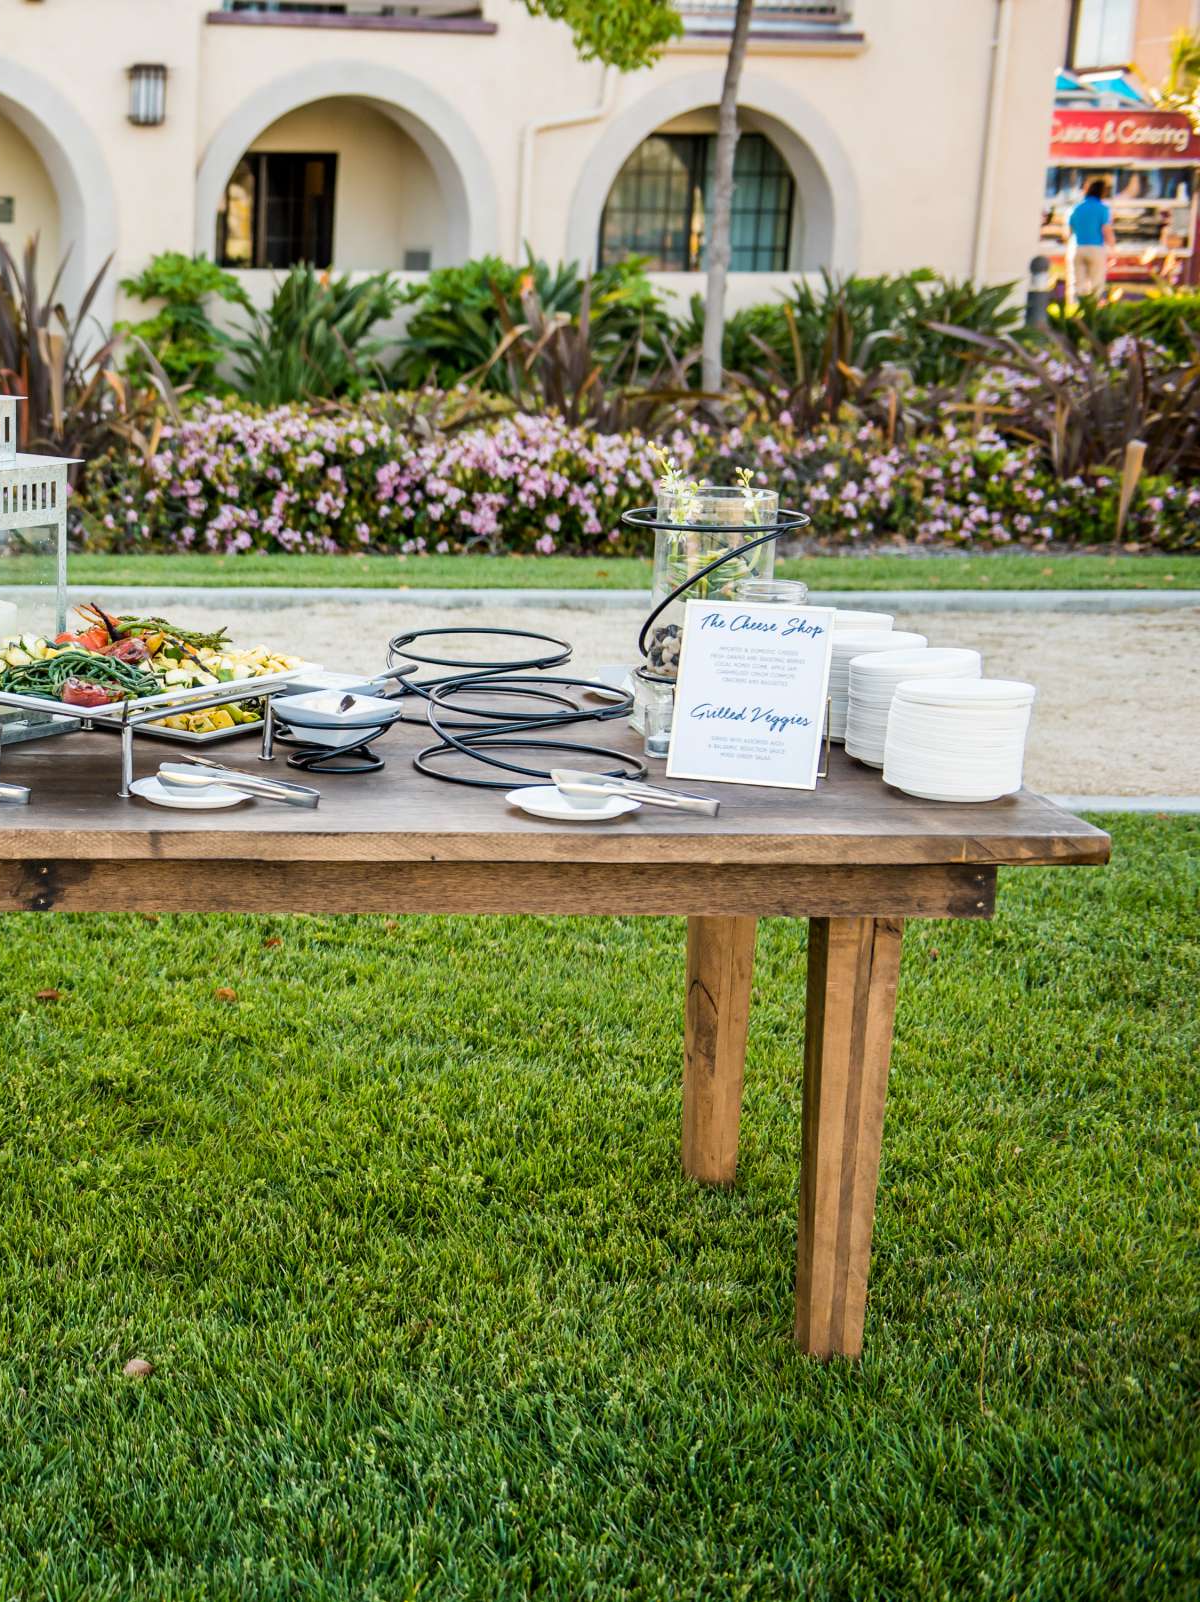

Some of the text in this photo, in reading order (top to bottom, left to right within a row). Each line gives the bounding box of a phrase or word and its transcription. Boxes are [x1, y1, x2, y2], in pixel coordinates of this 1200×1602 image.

[1117, 120, 1189, 152] Catering
[701, 613, 824, 638] The Cheese Shop
[690, 703, 813, 732] Grilled Veggies
